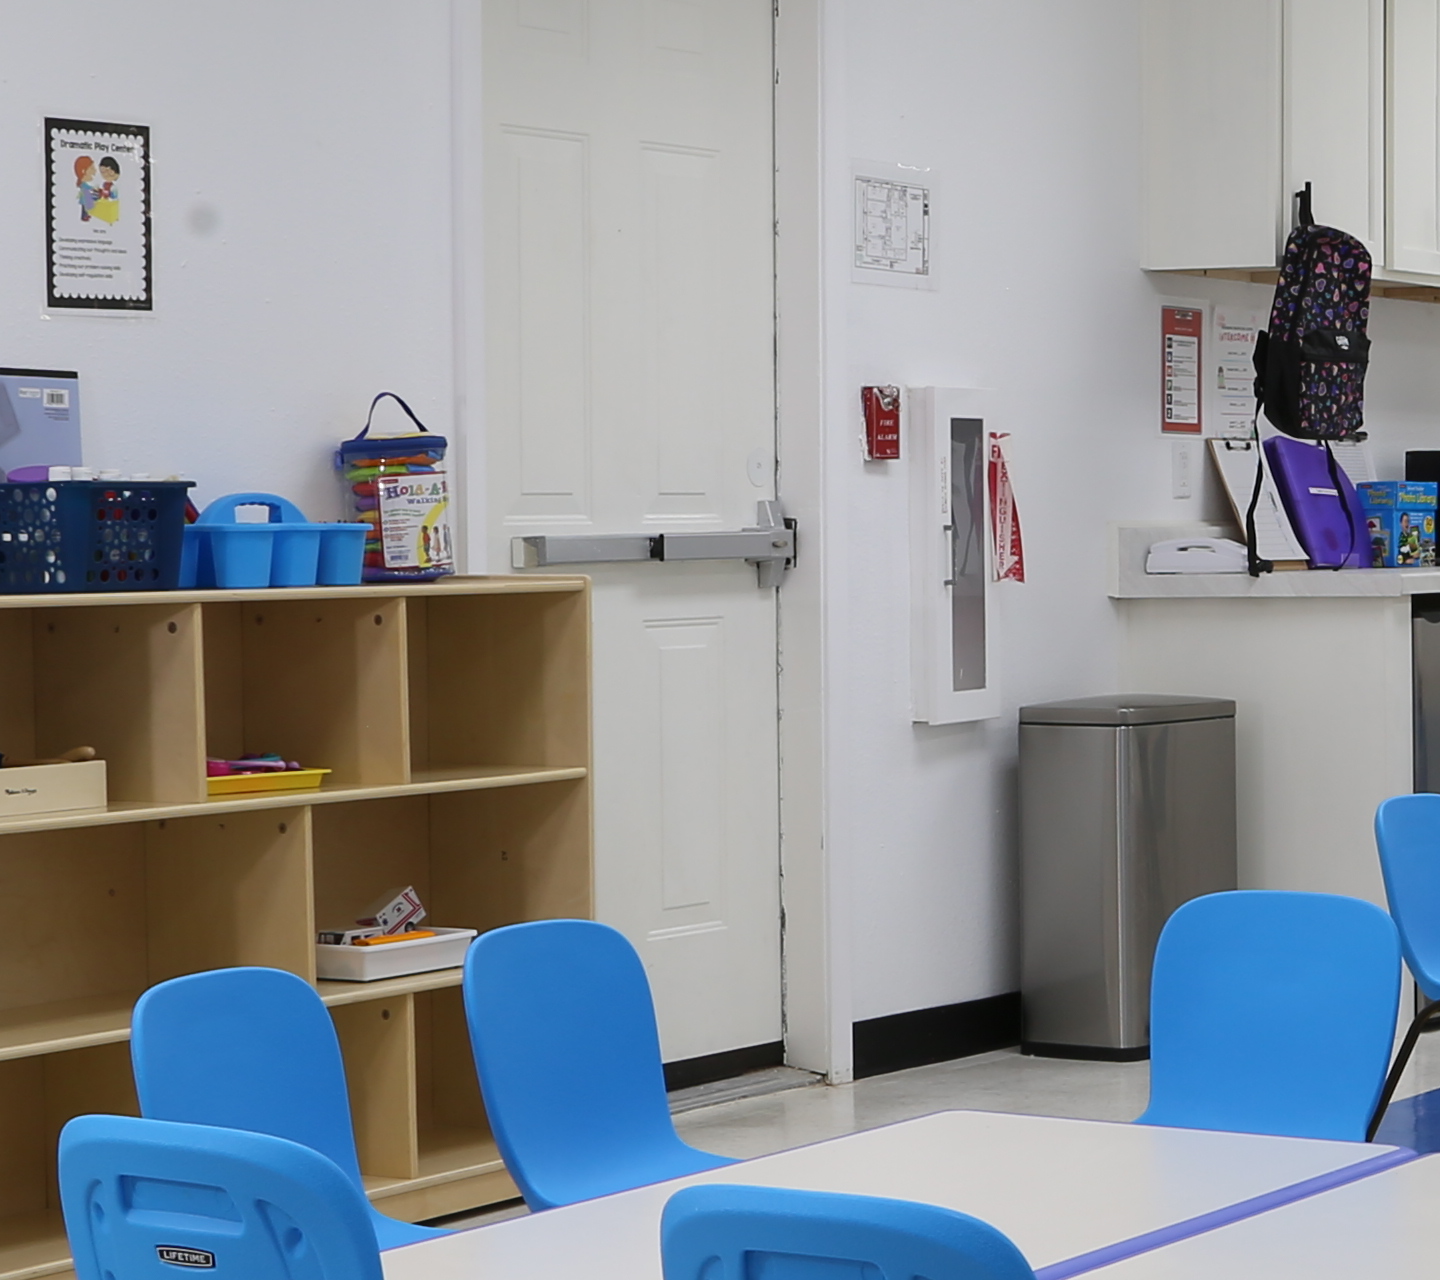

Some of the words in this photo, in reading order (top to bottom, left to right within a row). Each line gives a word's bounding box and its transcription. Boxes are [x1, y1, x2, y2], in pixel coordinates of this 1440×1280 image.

[60, 140, 92, 151] Dramatic
[94, 142, 109, 152] Play
[111, 143, 134, 153] Center
[998, 462, 1009, 569] EXTINGUISHER
[163, 1250, 206, 1263] LIFETIME
